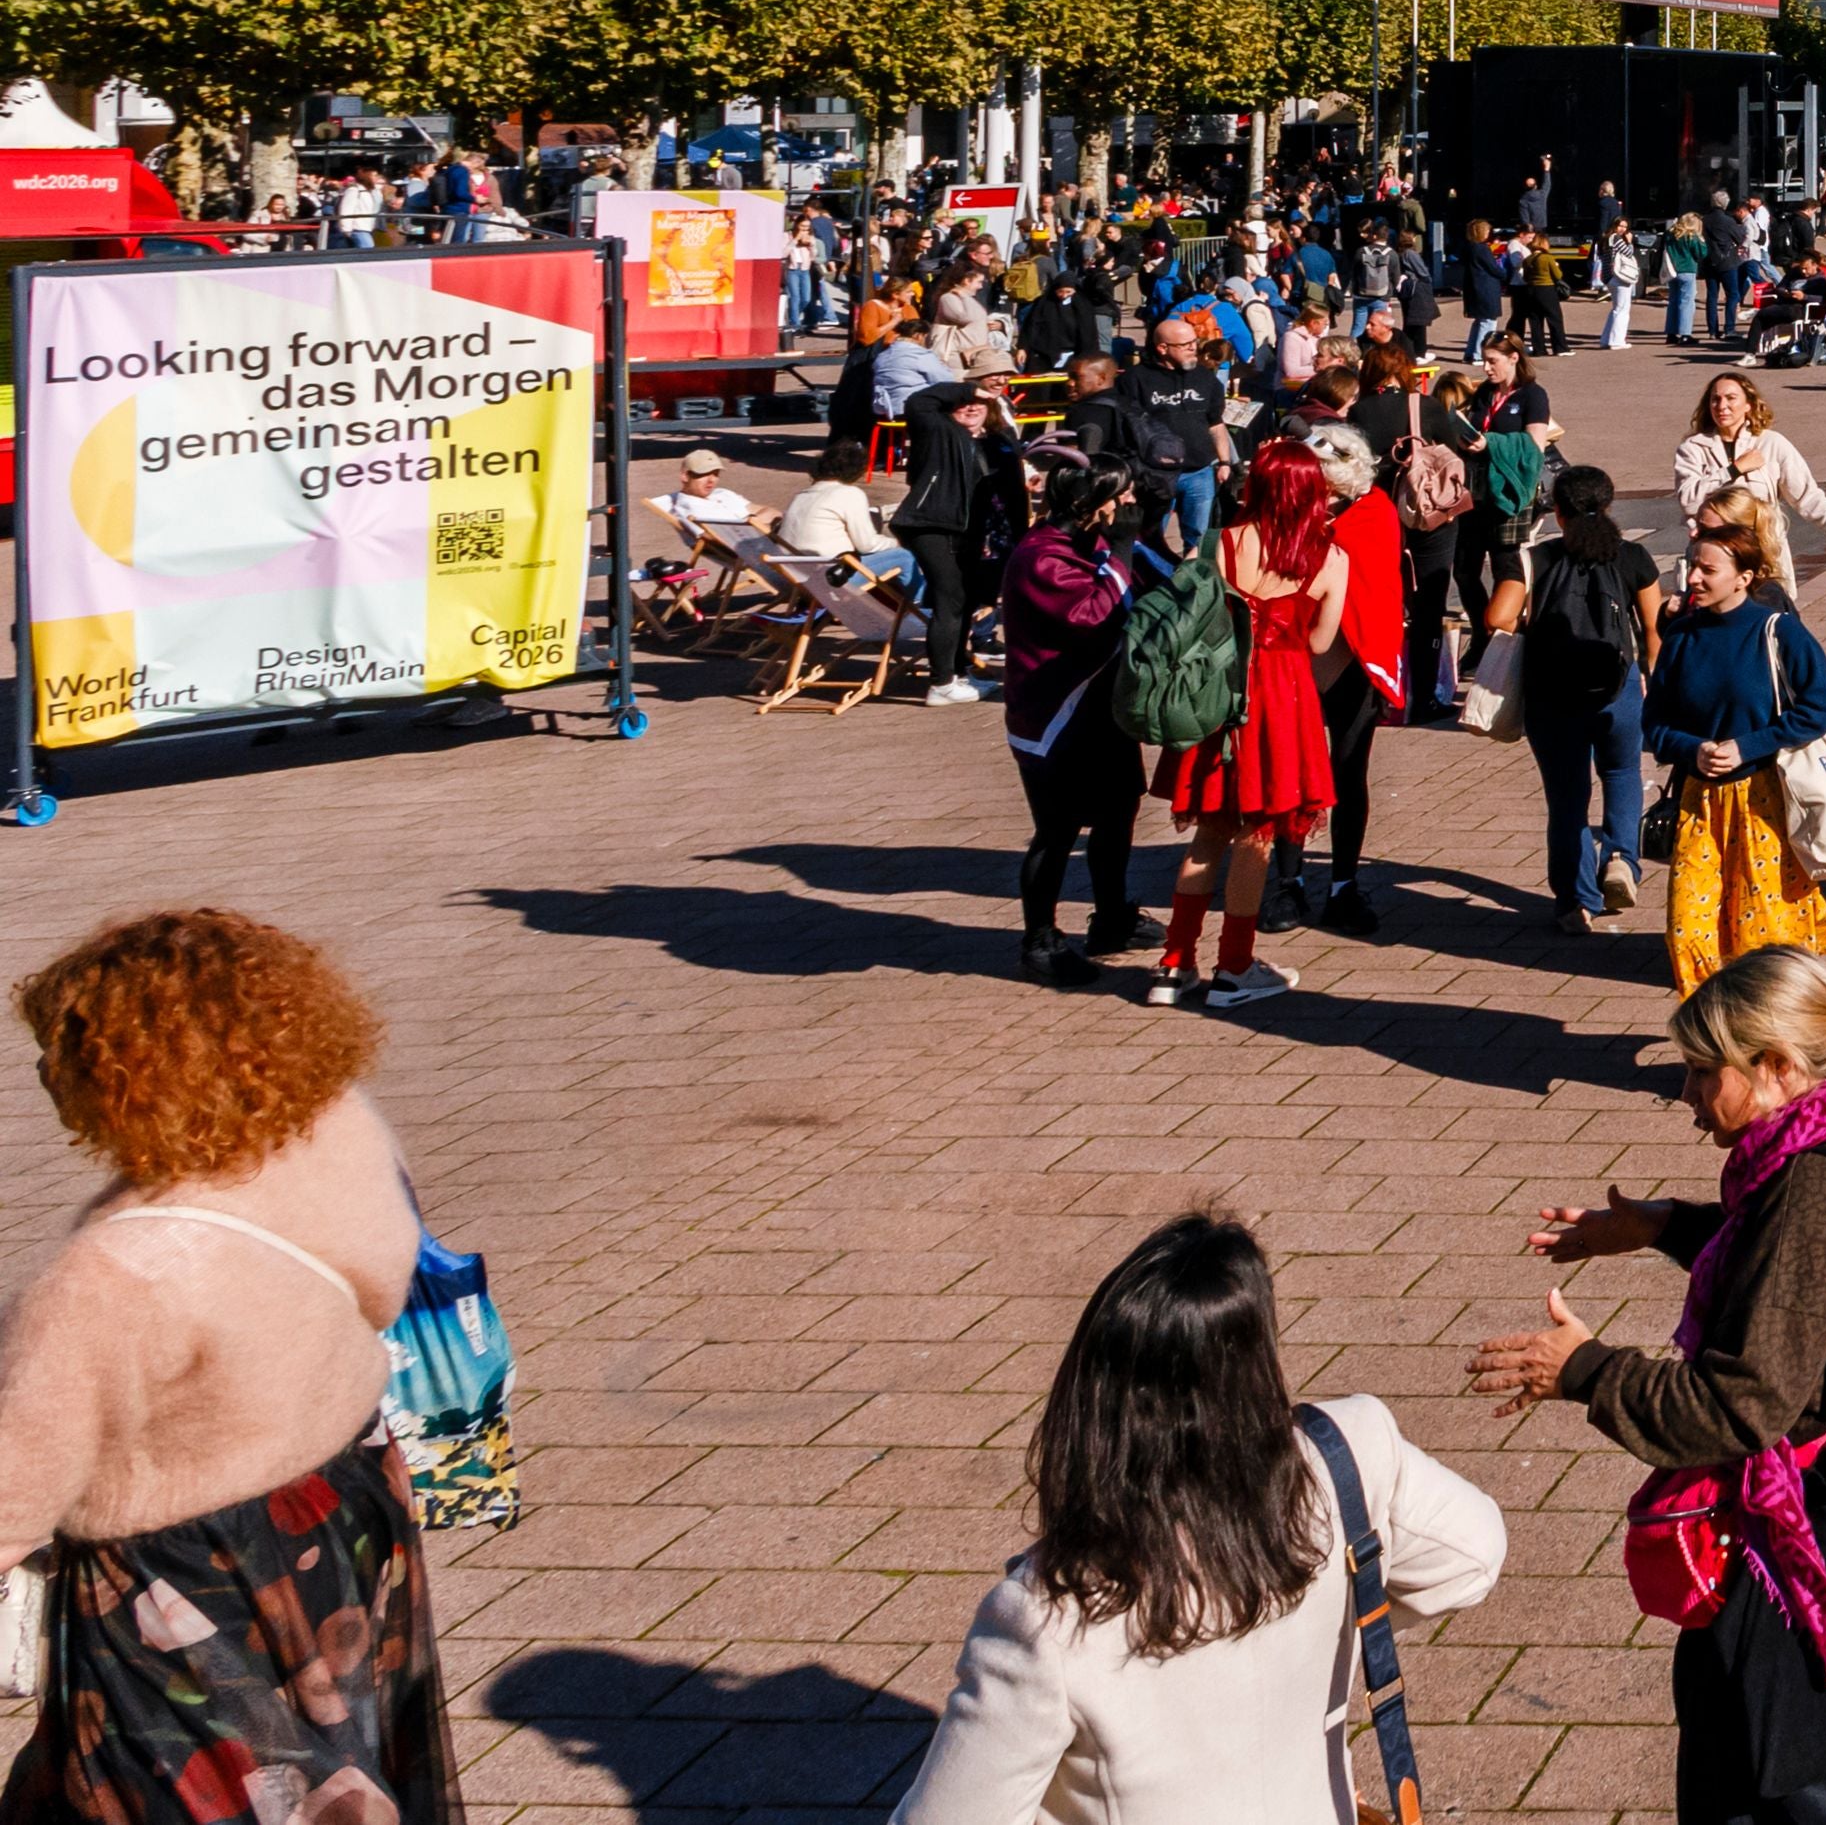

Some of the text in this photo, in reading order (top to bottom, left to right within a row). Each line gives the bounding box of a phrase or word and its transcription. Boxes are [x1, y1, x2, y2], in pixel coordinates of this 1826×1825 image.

[12, 174, 119, 193] wdc2026.org
[44, 339, 271, 384] Looking
[288, 322, 492, 368] forward
[262, 363, 573, 412] das Morgen
[139, 413, 451, 473] gemeinsam
[299, 443, 542, 501] gestalten
[469, 618, 567, 657] Capital
[498, 643, 565, 670] 2026
[258, 643, 367, 672] Design
[44, 664, 149, 699] World
[253, 660, 426, 695] RheinMain
[46, 683, 199, 727] Frankfurt
